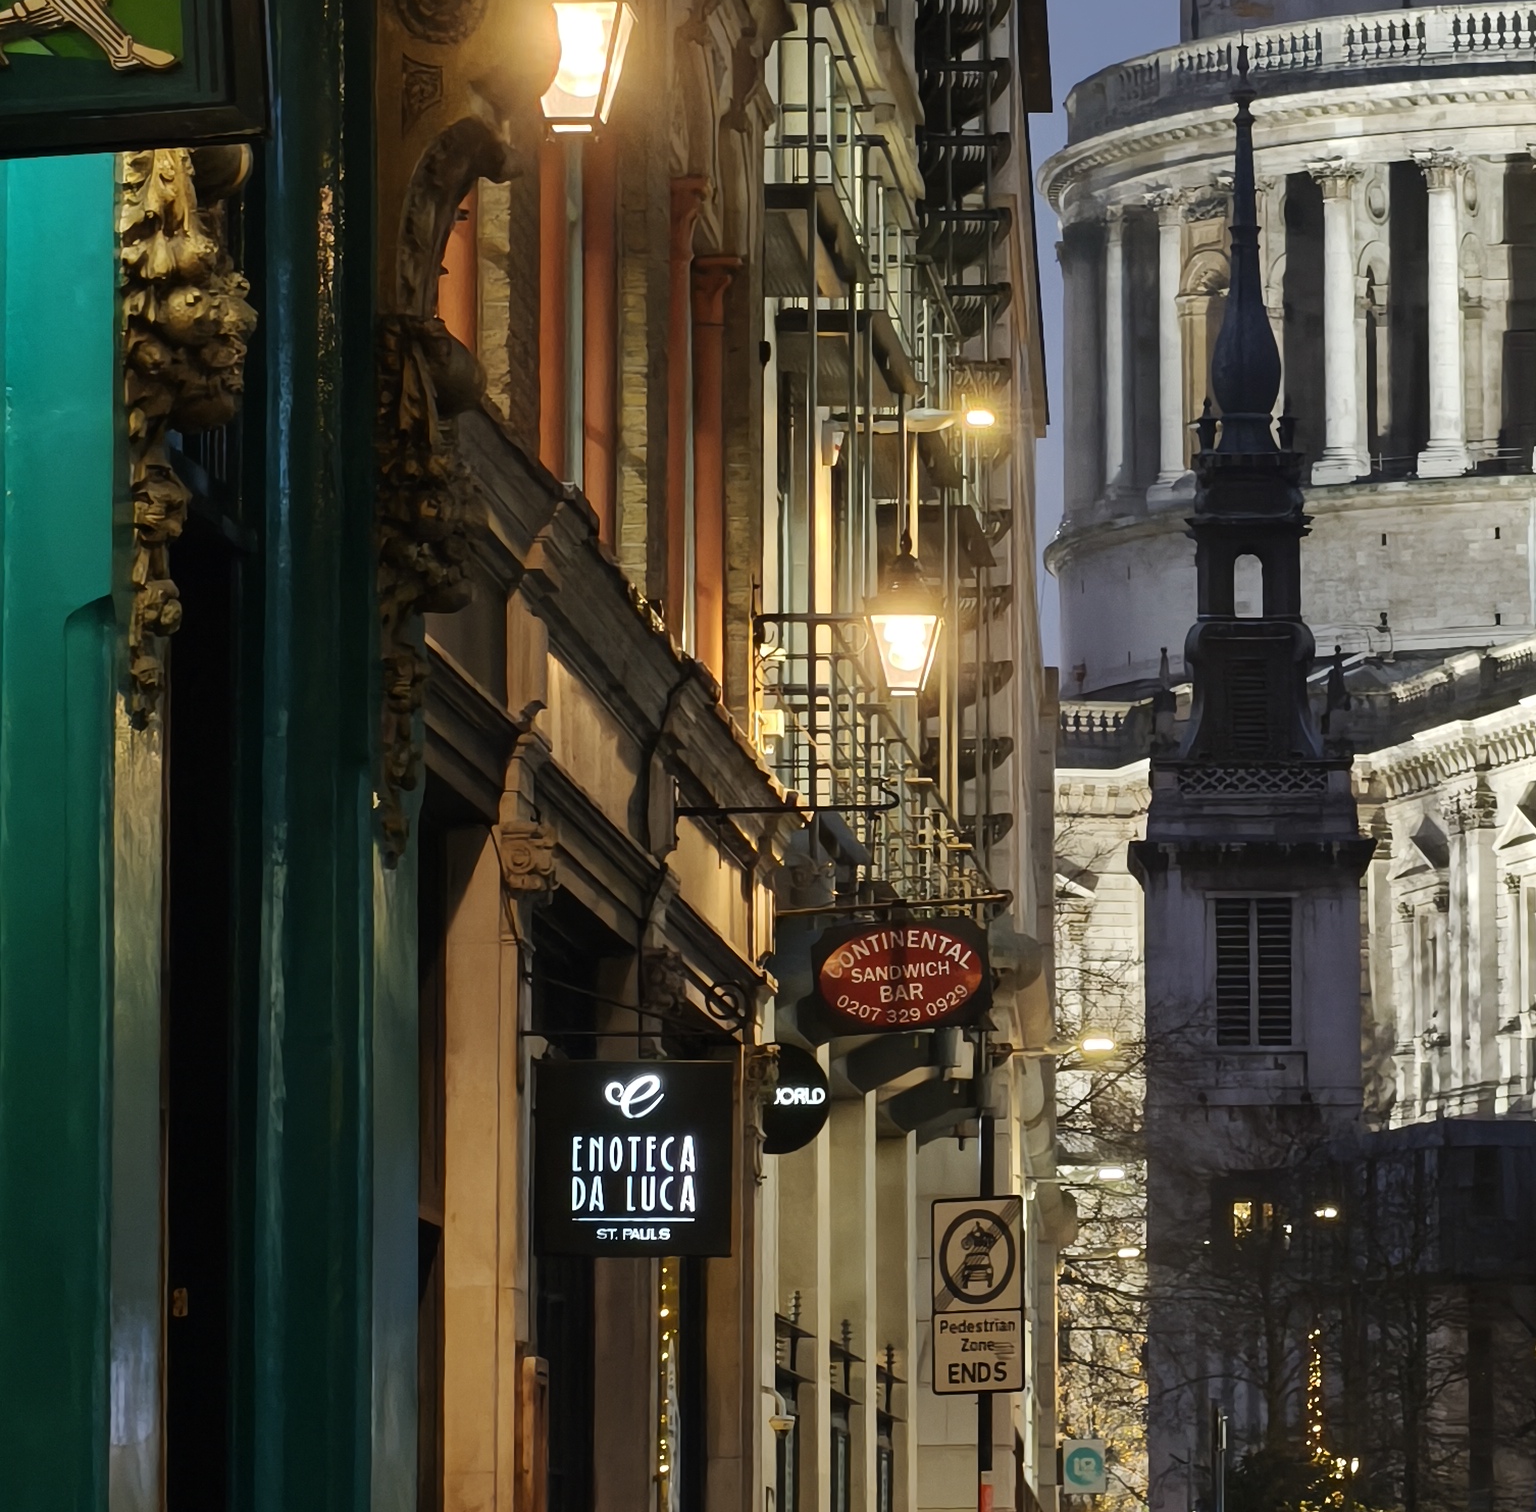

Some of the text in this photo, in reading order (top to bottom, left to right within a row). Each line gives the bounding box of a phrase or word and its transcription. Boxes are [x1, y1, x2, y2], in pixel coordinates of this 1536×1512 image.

[825, 929, 972, 979] CONTINENTAL
[851, 960, 950, 984] SANDWICH
[836, 984, 968, 1023] 0207 329 0929
[880, 982, 924, 1003] BAR
[571, 1135, 696, 1173] ENOTECA
[571, 1174, 696, 1213] DA LUCA
[596, 1228, 618, 1241] ST.
[939, 1318, 1016, 1334] Pedestrian
[960, 1338, 996, 1352] Zone
[948, 1361, 1008, 1384] ENDS
